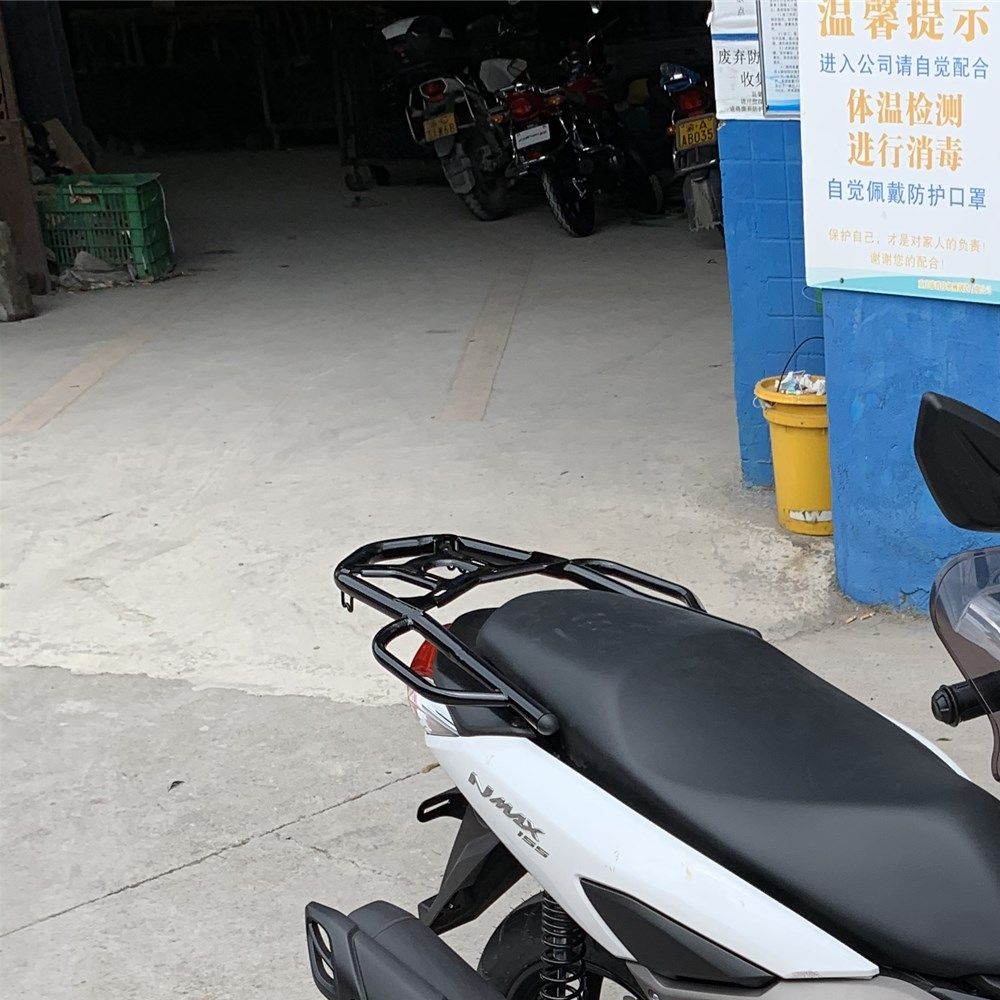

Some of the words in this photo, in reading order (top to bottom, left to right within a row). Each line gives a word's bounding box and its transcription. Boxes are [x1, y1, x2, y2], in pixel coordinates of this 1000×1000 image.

[818, 0, 990, 42] 温馨提示
[820, 53, 989, 79] 进入公司请自觉配合
[847, 89, 964, 128] 体温检测
[848, 131, 962, 171] 进行消毒
[828, 178, 986, 210] 自觉佩戴防护口罩
[468, 771, 546, 842] NMAX
